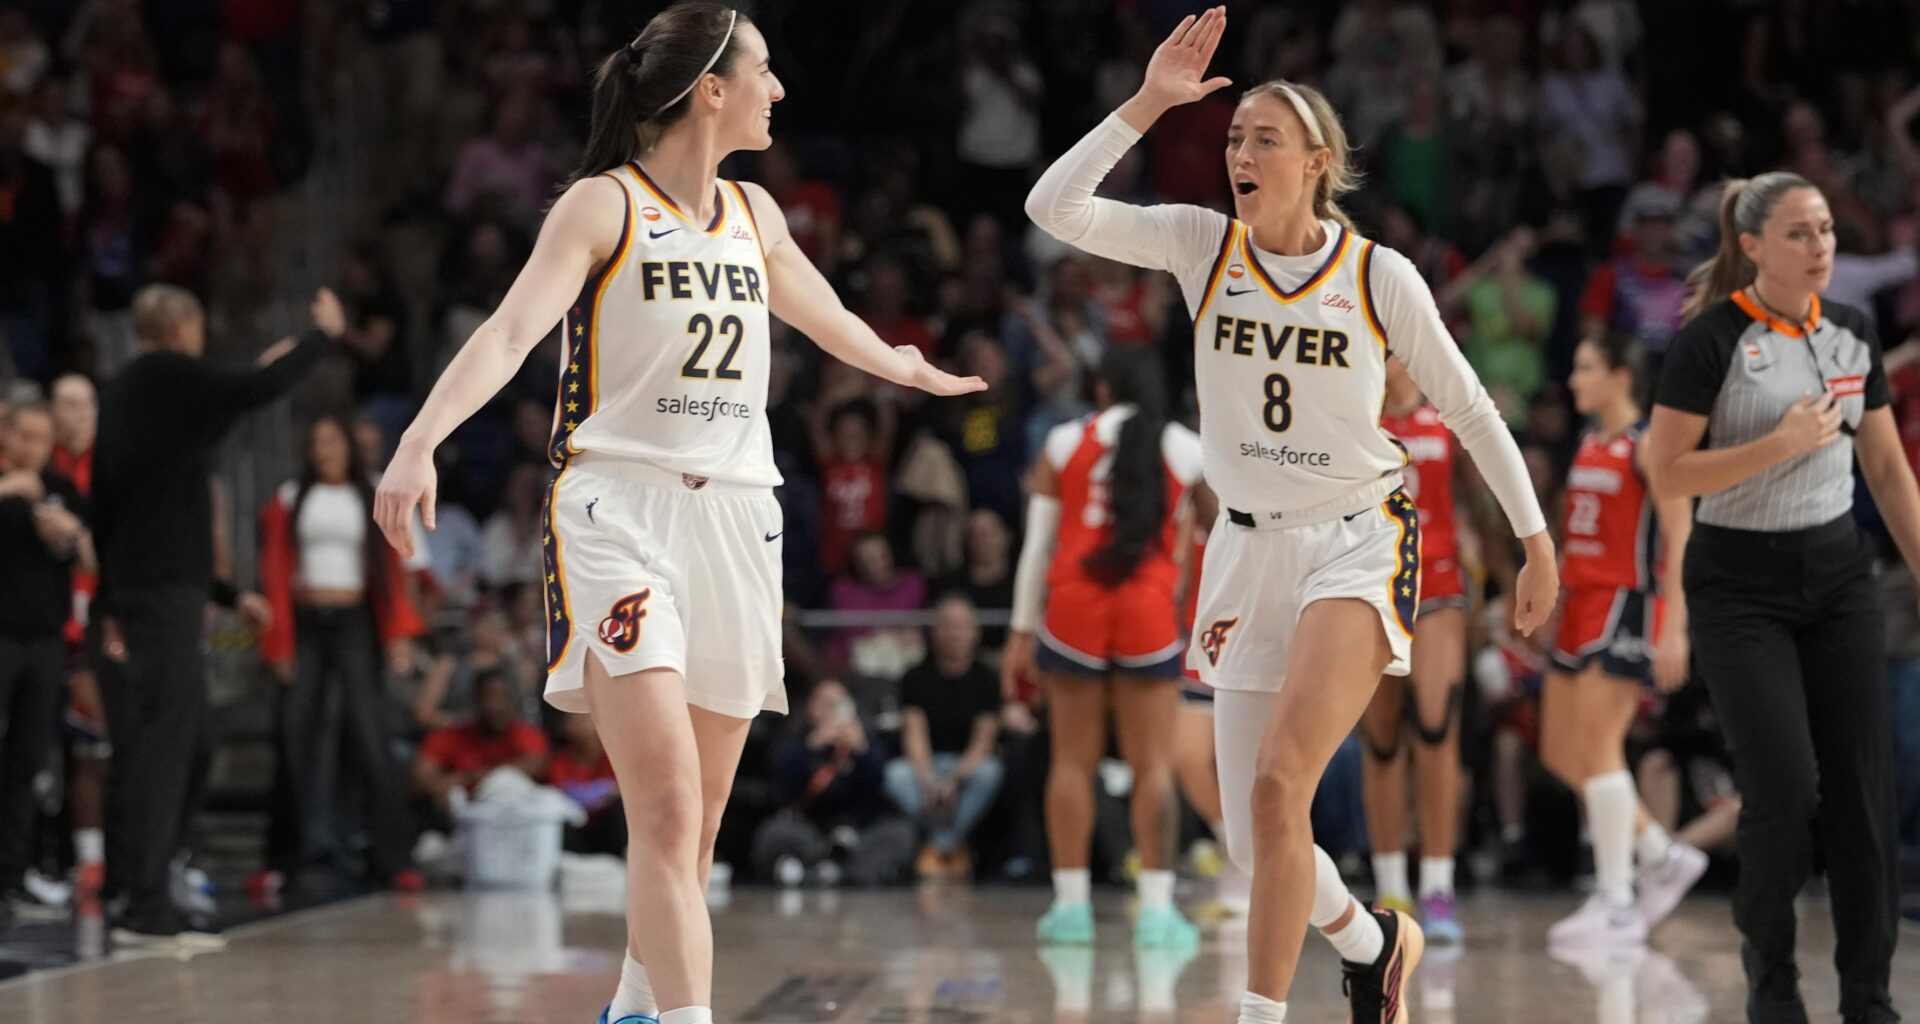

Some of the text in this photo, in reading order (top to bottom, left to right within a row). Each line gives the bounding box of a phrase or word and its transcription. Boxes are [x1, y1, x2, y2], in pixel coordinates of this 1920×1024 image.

[640, 260, 764, 305] FEVER
[1321, 293, 1355, 313] Lilly
[681, 312, 744, 380] 22
[1213, 314, 1351, 368] FEVER
[656, 394, 750, 422] salesforce
[1262, 372, 1293, 433] 8
[1239, 441, 1330, 466] salesforce
